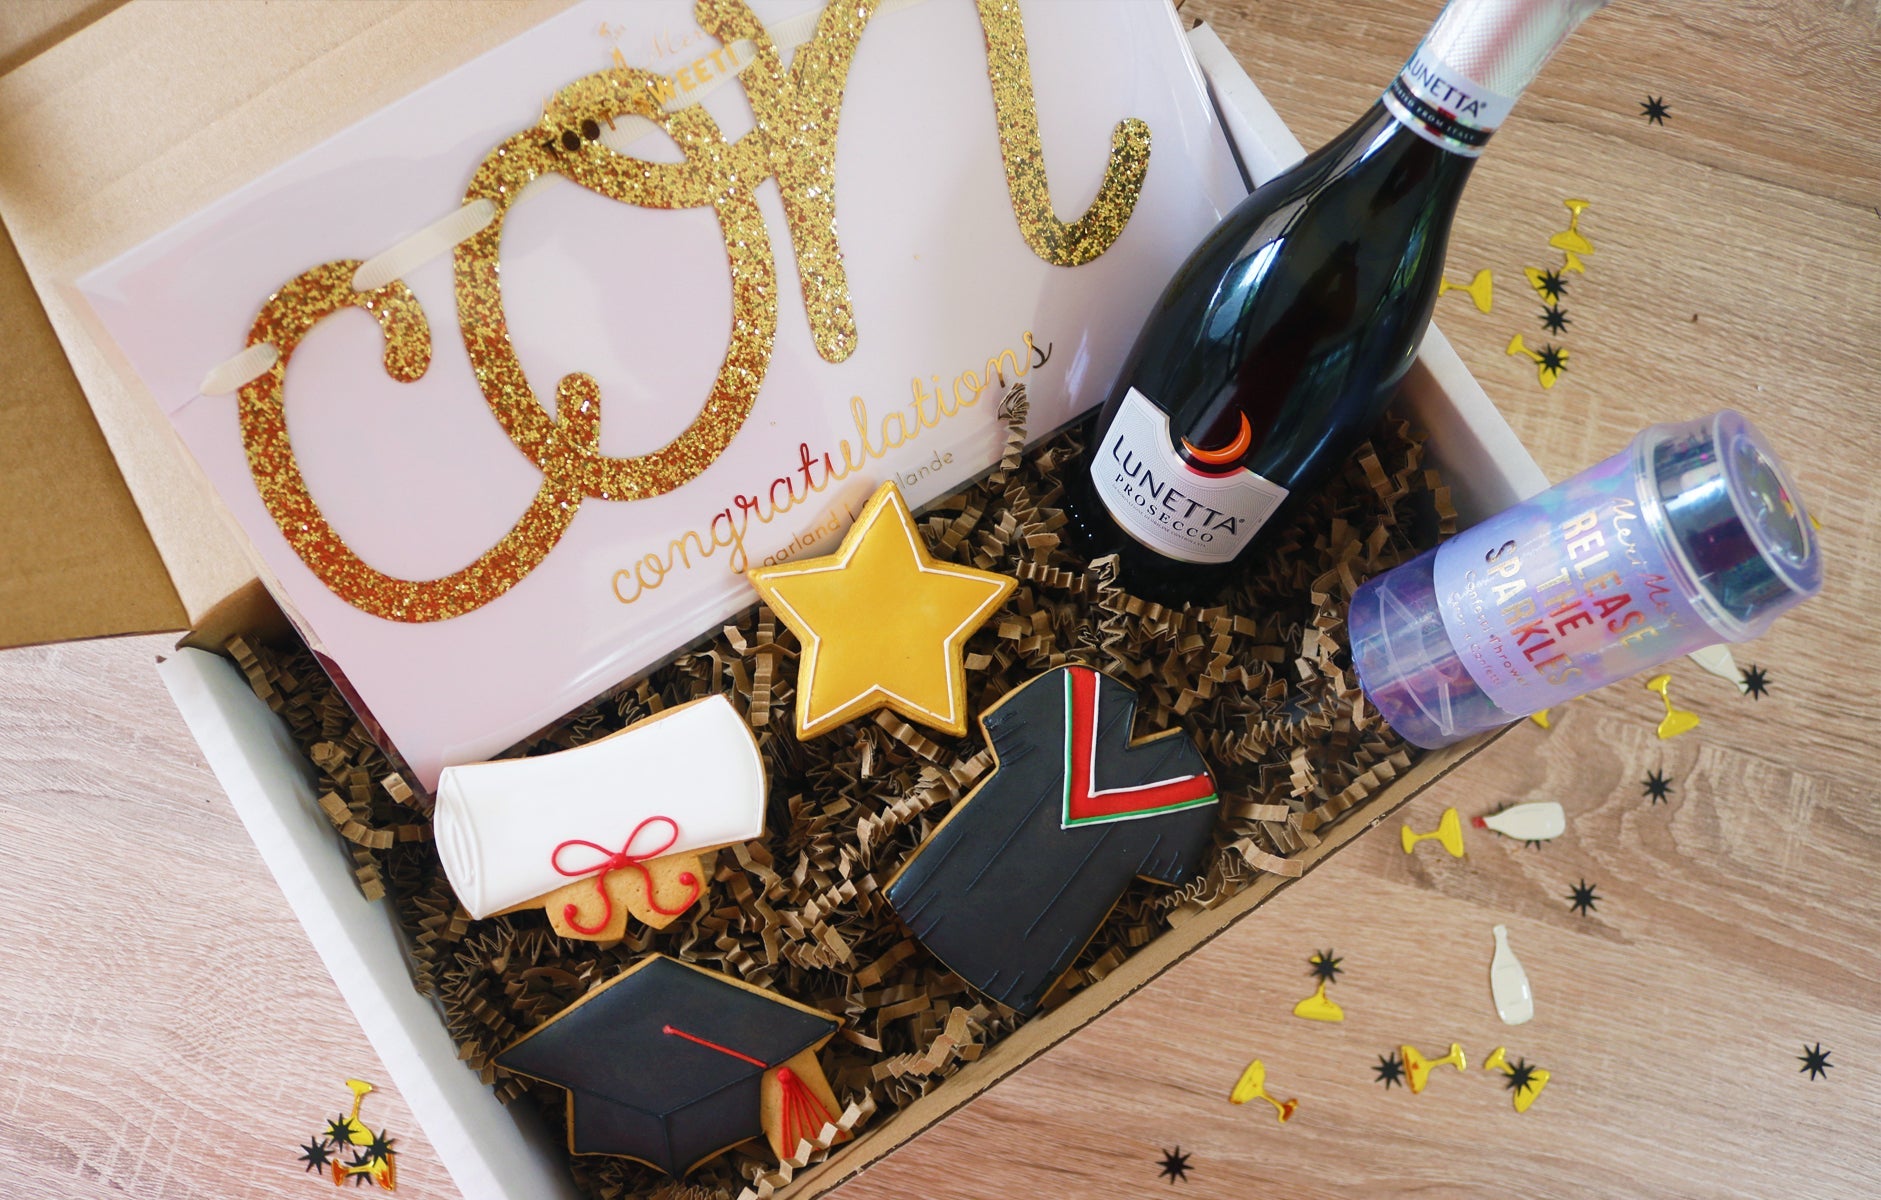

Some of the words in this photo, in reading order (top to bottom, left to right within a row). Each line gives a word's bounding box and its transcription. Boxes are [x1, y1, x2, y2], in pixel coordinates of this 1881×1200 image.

[1416, 105, 1444, 129] FROM
[611, 330, 1053, 604] congratulations
[1114, 472, 1214, 544] PROSECCO
[1611, 496, 1648, 567] Meri
[1485, 538, 1584, 686] SPARKLES
[1536, 566, 1596, 637] THE
[1562, 509, 1661, 649] RELEASE
